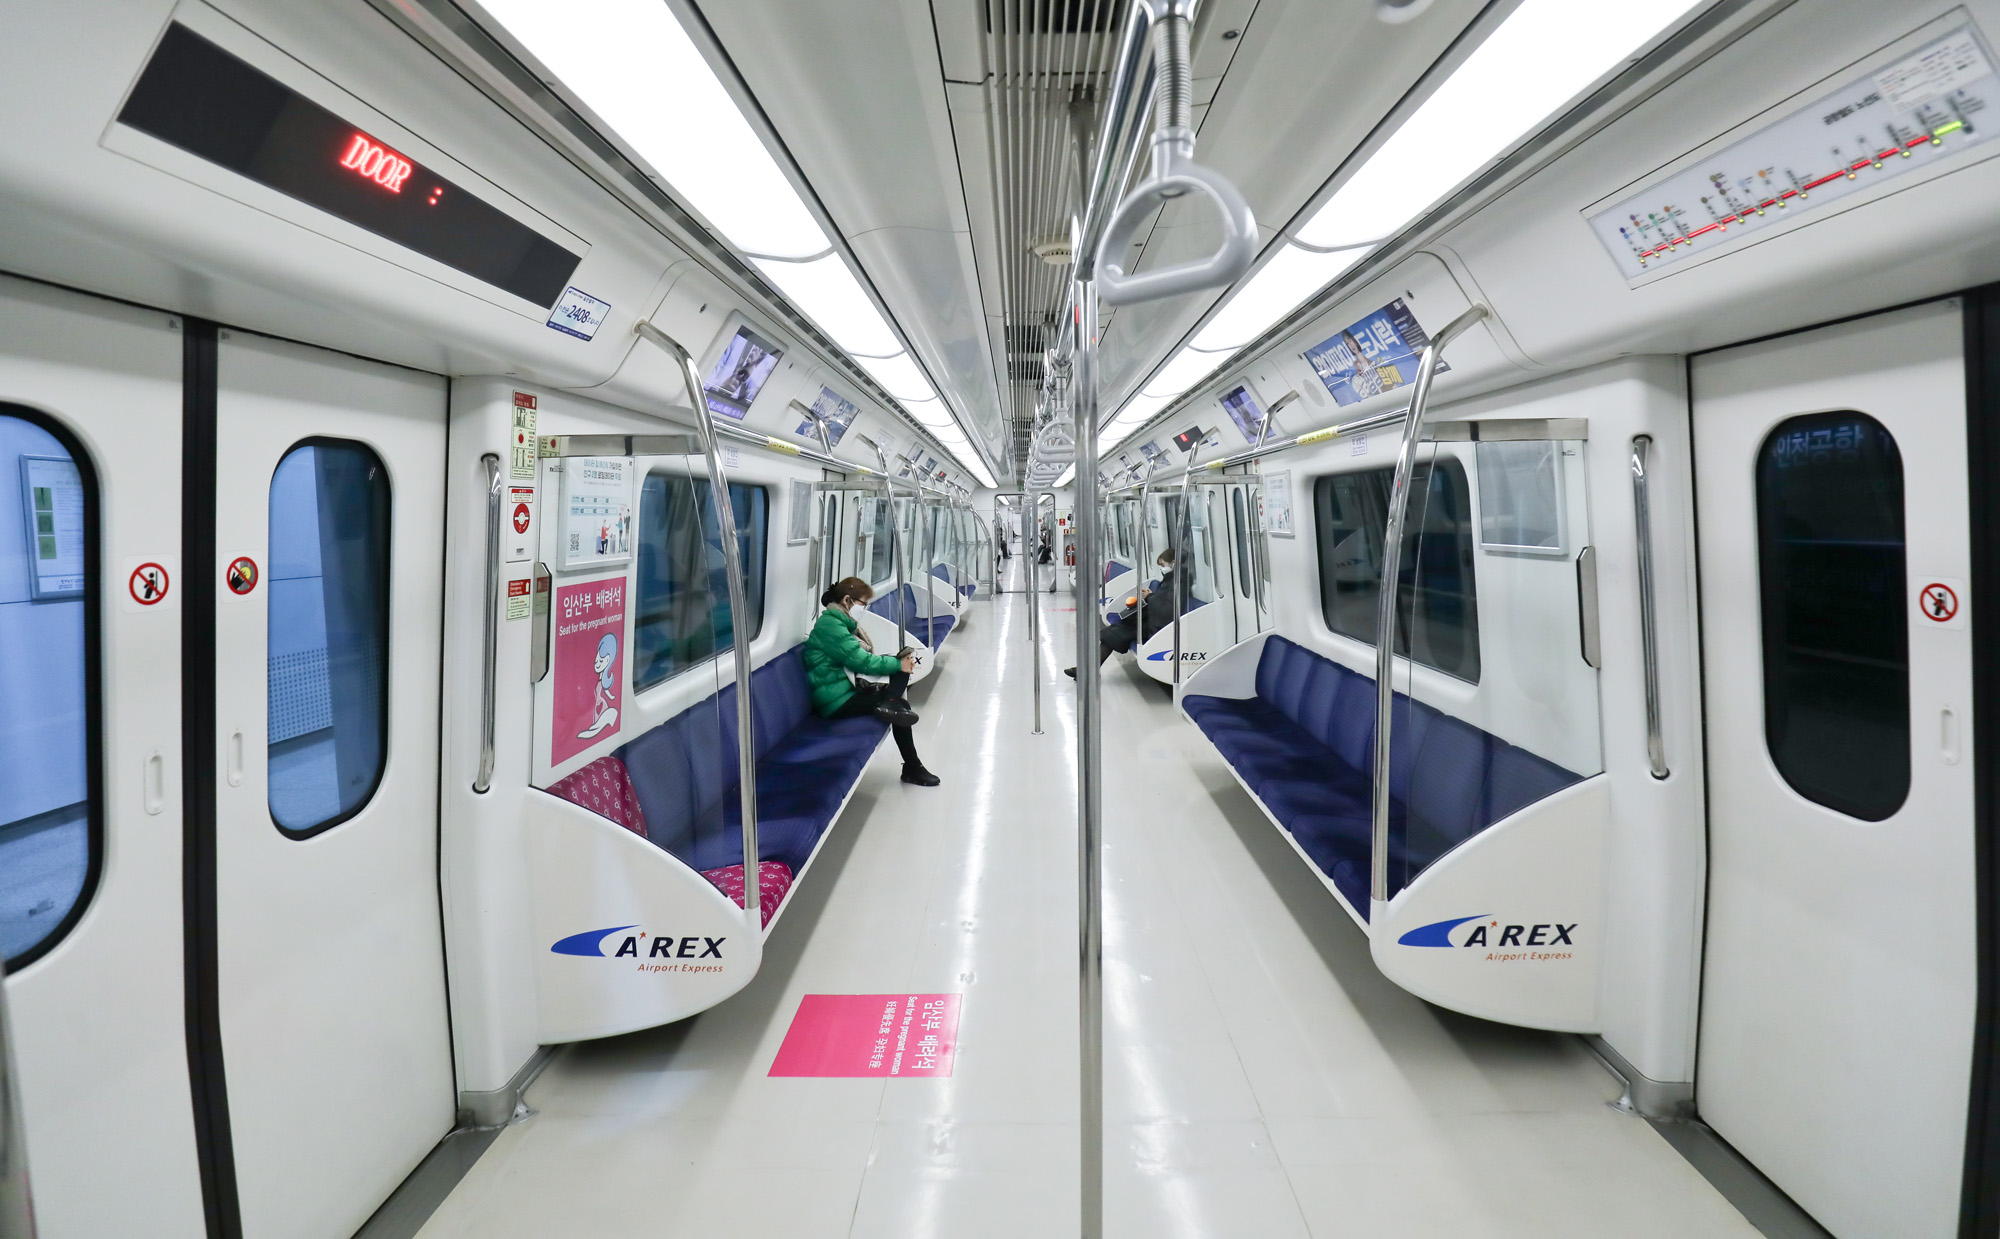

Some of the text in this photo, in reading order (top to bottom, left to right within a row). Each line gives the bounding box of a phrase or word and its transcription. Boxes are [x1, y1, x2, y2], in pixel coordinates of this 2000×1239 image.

[341, 135, 412, 193] DOOR
[1354, 318, 1400, 358] 도시락
[563, 586, 622, 619] 임산부 배려석
[559, 613, 623, 636] Seat for the pregnant woman
[637, 963, 724, 974] Airport Express
[1484, 951, 1573, 963] Airport Express
[890, 996, 918, 1075] Seat for the pregnant woman
[911, 1000, 945, 1069] 임산부 배려석
